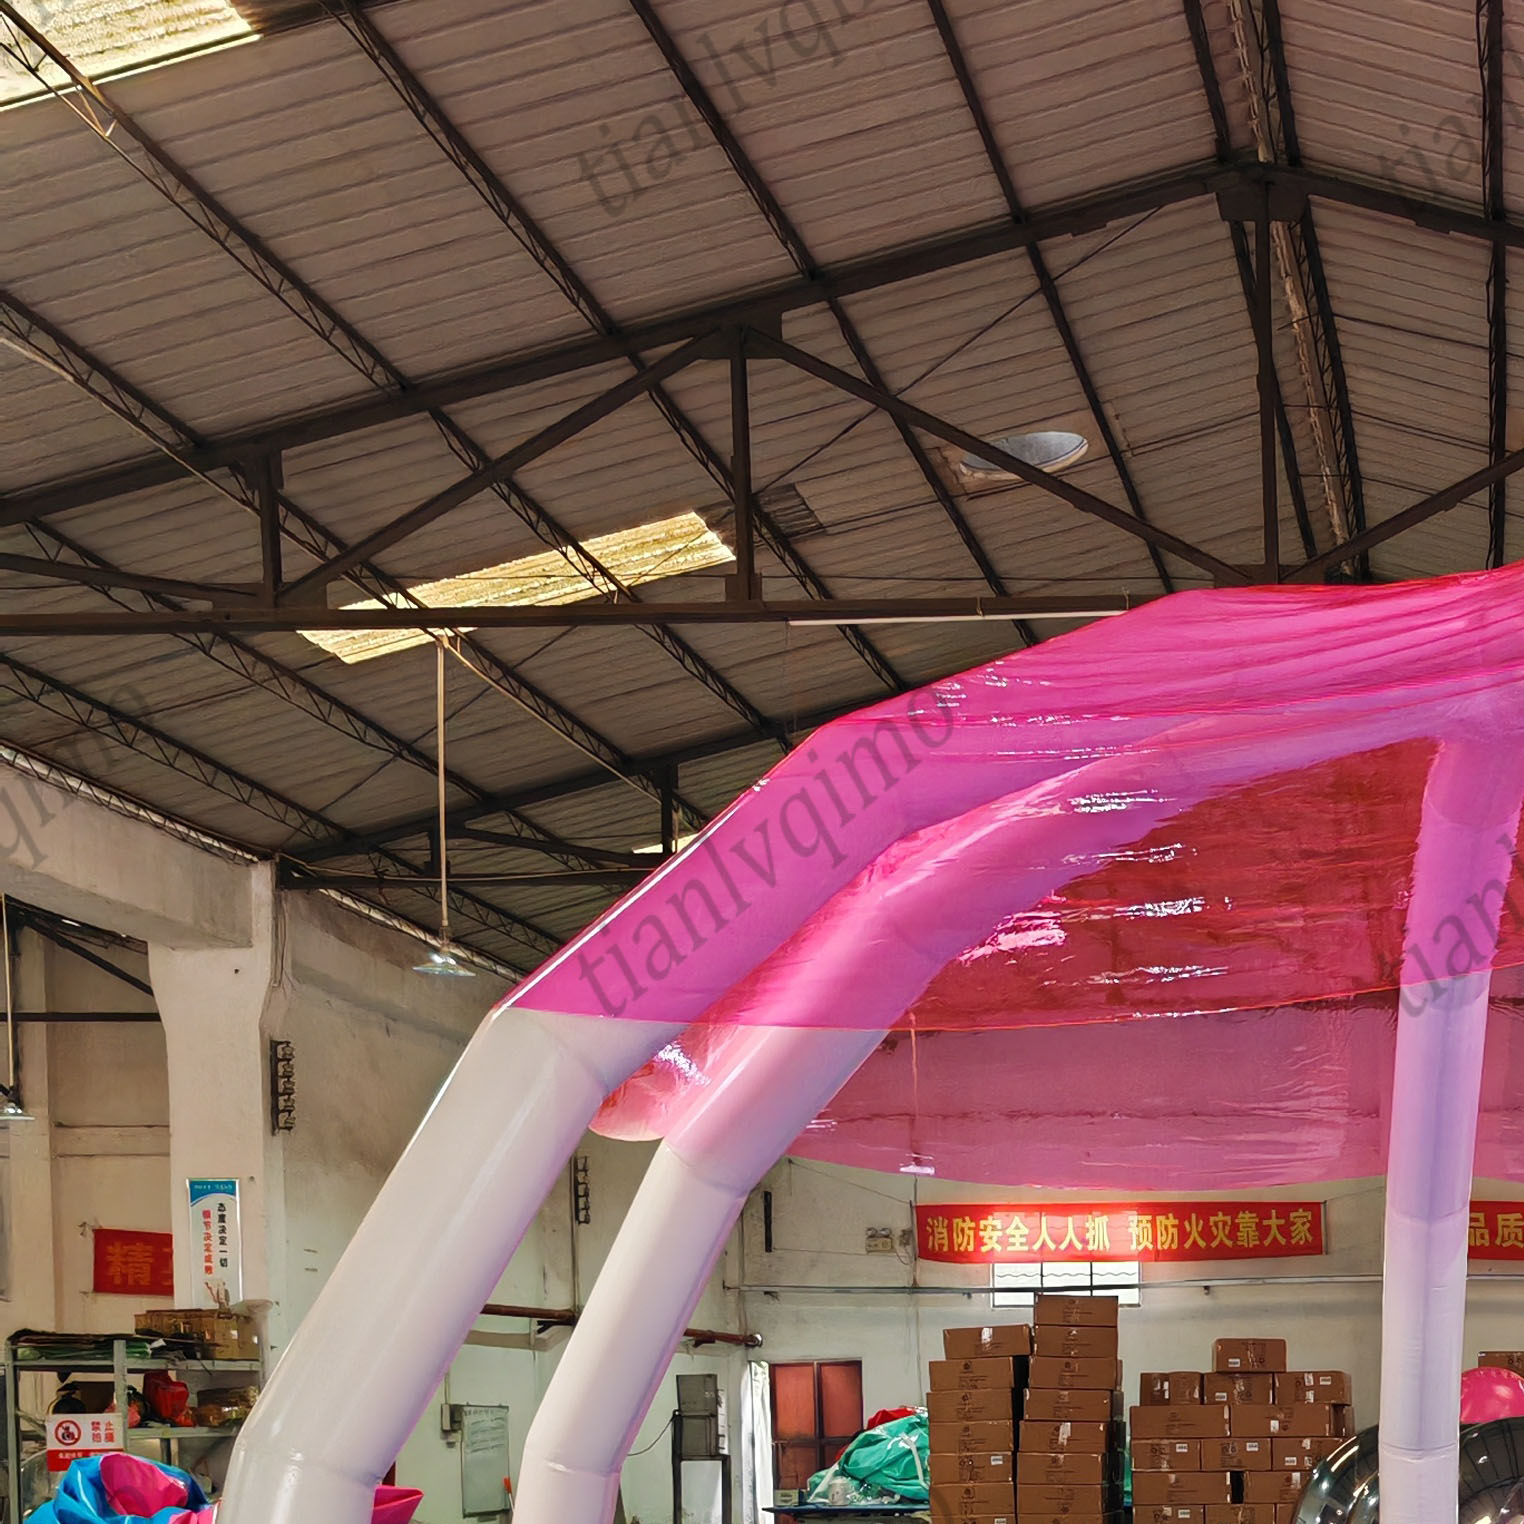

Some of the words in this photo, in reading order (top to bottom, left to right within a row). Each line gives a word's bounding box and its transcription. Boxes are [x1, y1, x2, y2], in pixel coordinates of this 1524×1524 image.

[926, 1214, 1110, 1253] 消防安全人人抓
[1128, 1208, 1313, 1252] 预防火灾靠大家
